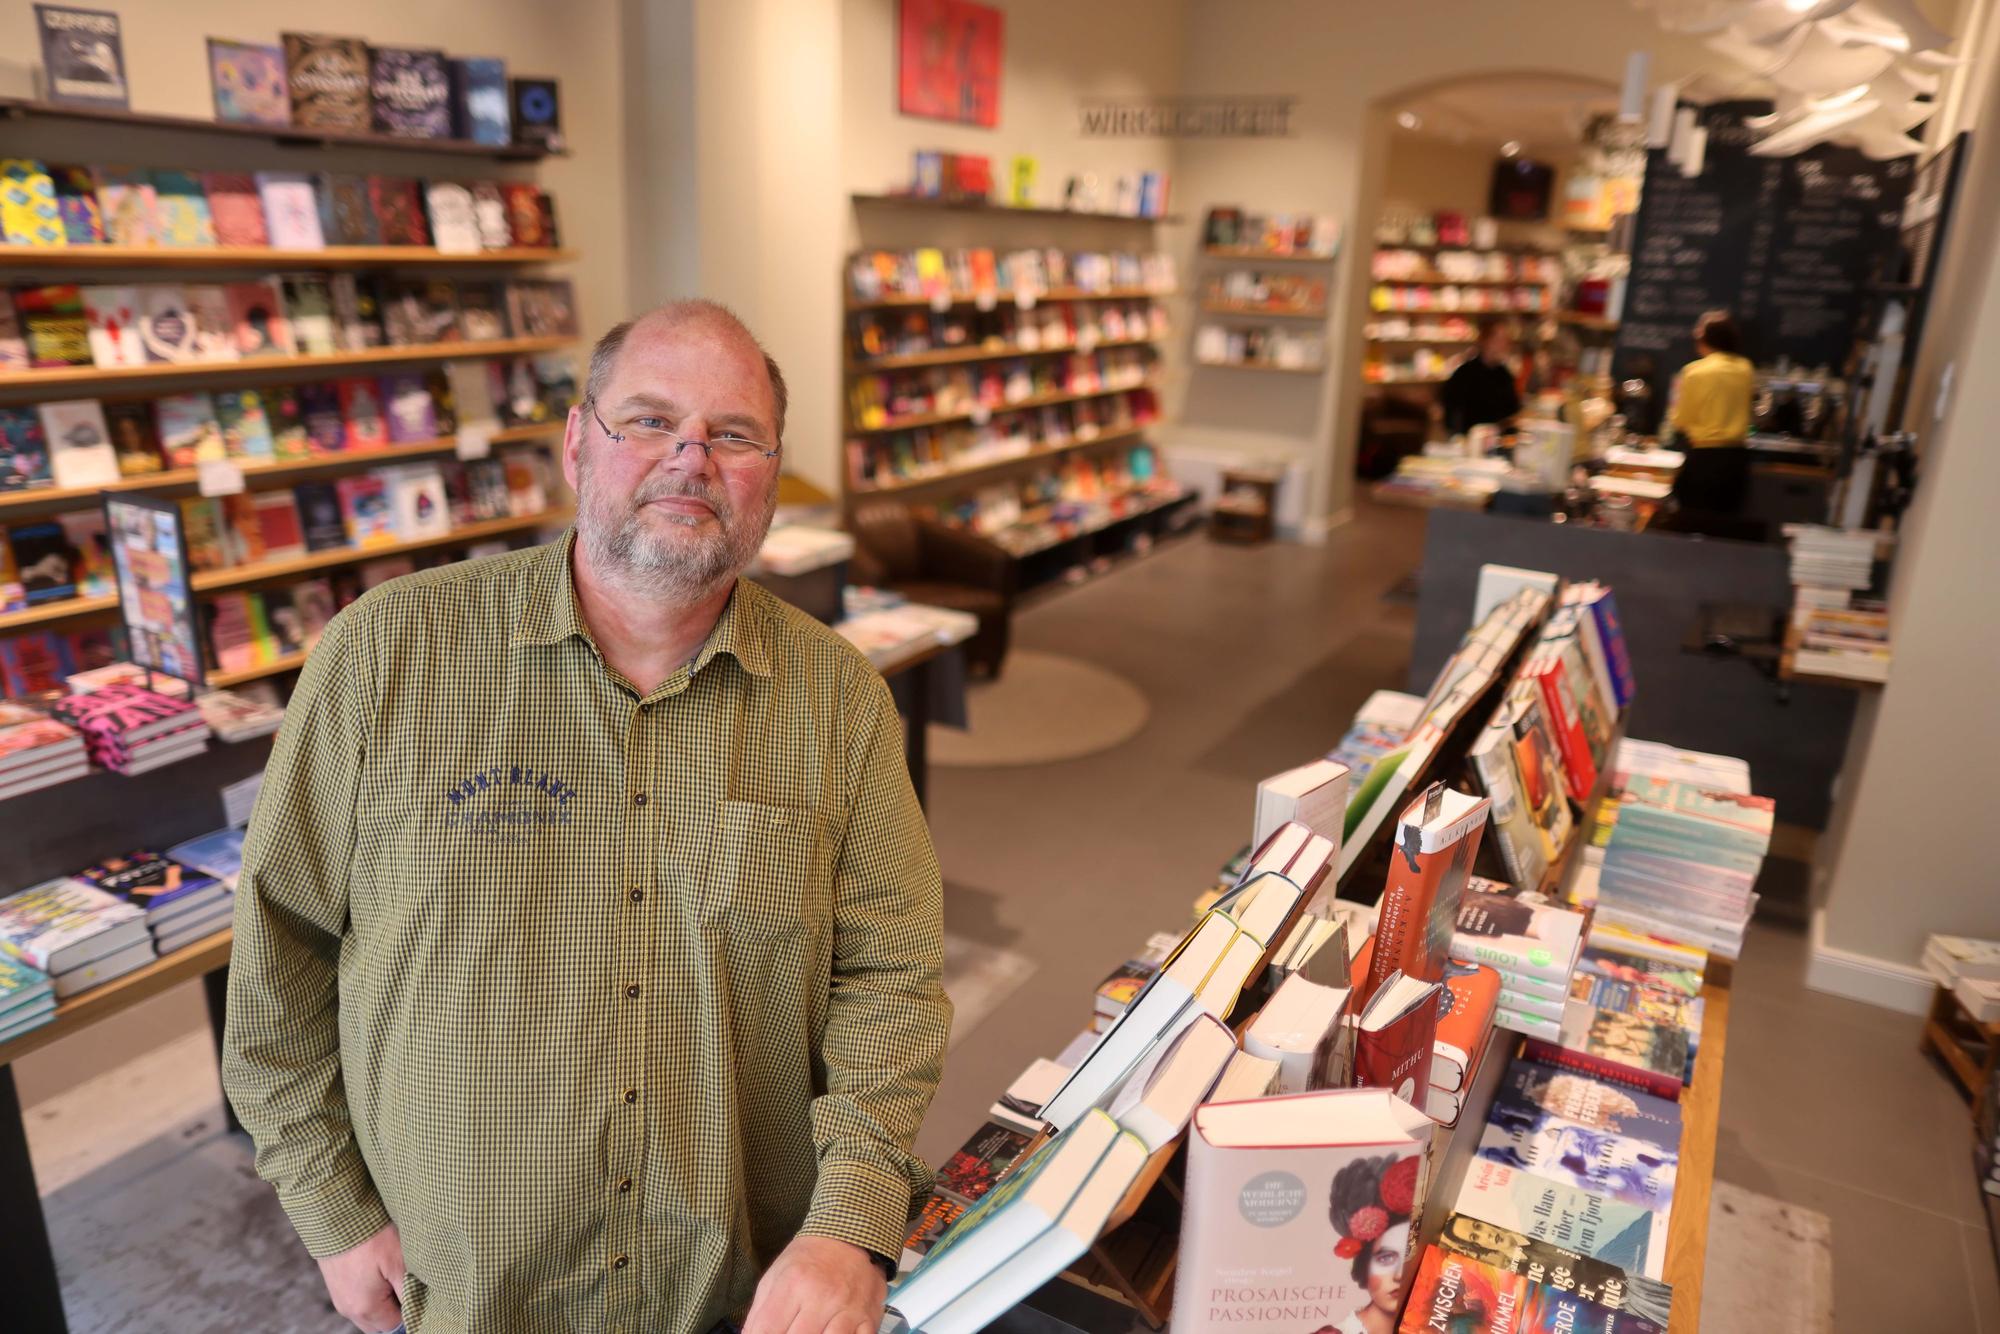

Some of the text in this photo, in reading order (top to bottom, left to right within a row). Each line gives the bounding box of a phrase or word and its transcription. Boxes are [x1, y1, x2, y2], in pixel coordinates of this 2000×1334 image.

[446, 765, 577, 805] MONT BLANC
[1391, 920, 1408, 973] KENNED
[1475, 946, 1519, 968] LOUIS
[1391, 1047, 1425, 1081] MITHU
[1264, 1181, 1282, 1190] DIE
[1244, 1198, 1300, 1208] MODERNE
[1528, 1188, 1557, 1240] Das Haus
[1580, 1193, 1603, 1226] Fjord
[943, 1205, 966, 1224] Die
[1551, 1209, 1575, 1242] über
[1556, 1248, 1582, 1261] PIPER
[1211, 1285, 1347, 1303] PROSAISCHE
[1428, 1262, 1464, 1333] ZWISCHEN
[1209, 1305, 1330, 1322] PASSIONEN
[1604, 1314, 1615, 1334] OWLER
